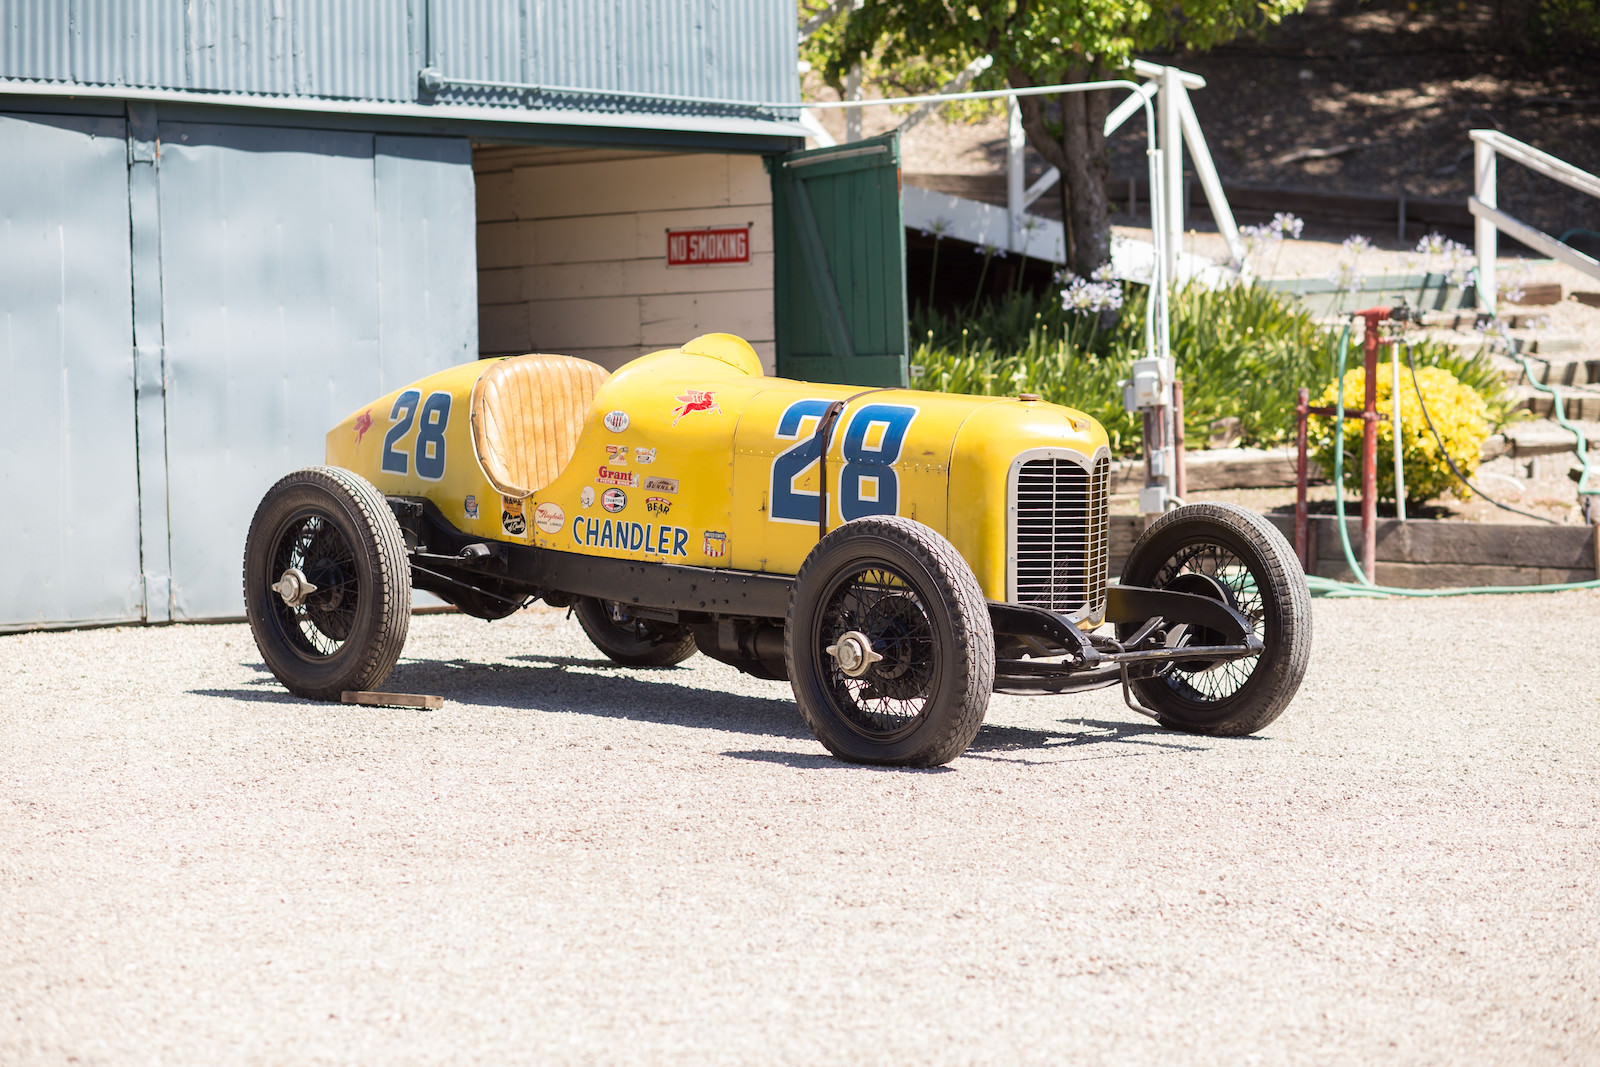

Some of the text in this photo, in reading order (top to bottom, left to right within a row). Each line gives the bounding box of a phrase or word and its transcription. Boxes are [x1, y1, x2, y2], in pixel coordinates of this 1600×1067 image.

[670, 233, 746, 261] NO SMOKING
[381, 388, 452, 482] 28
[598, 466, 633, 481] Grant
[769, 398, 920, 527] 28
[647, 502, 670, 515] BEAR
[573, 515, 689, 557] CHANDLER
